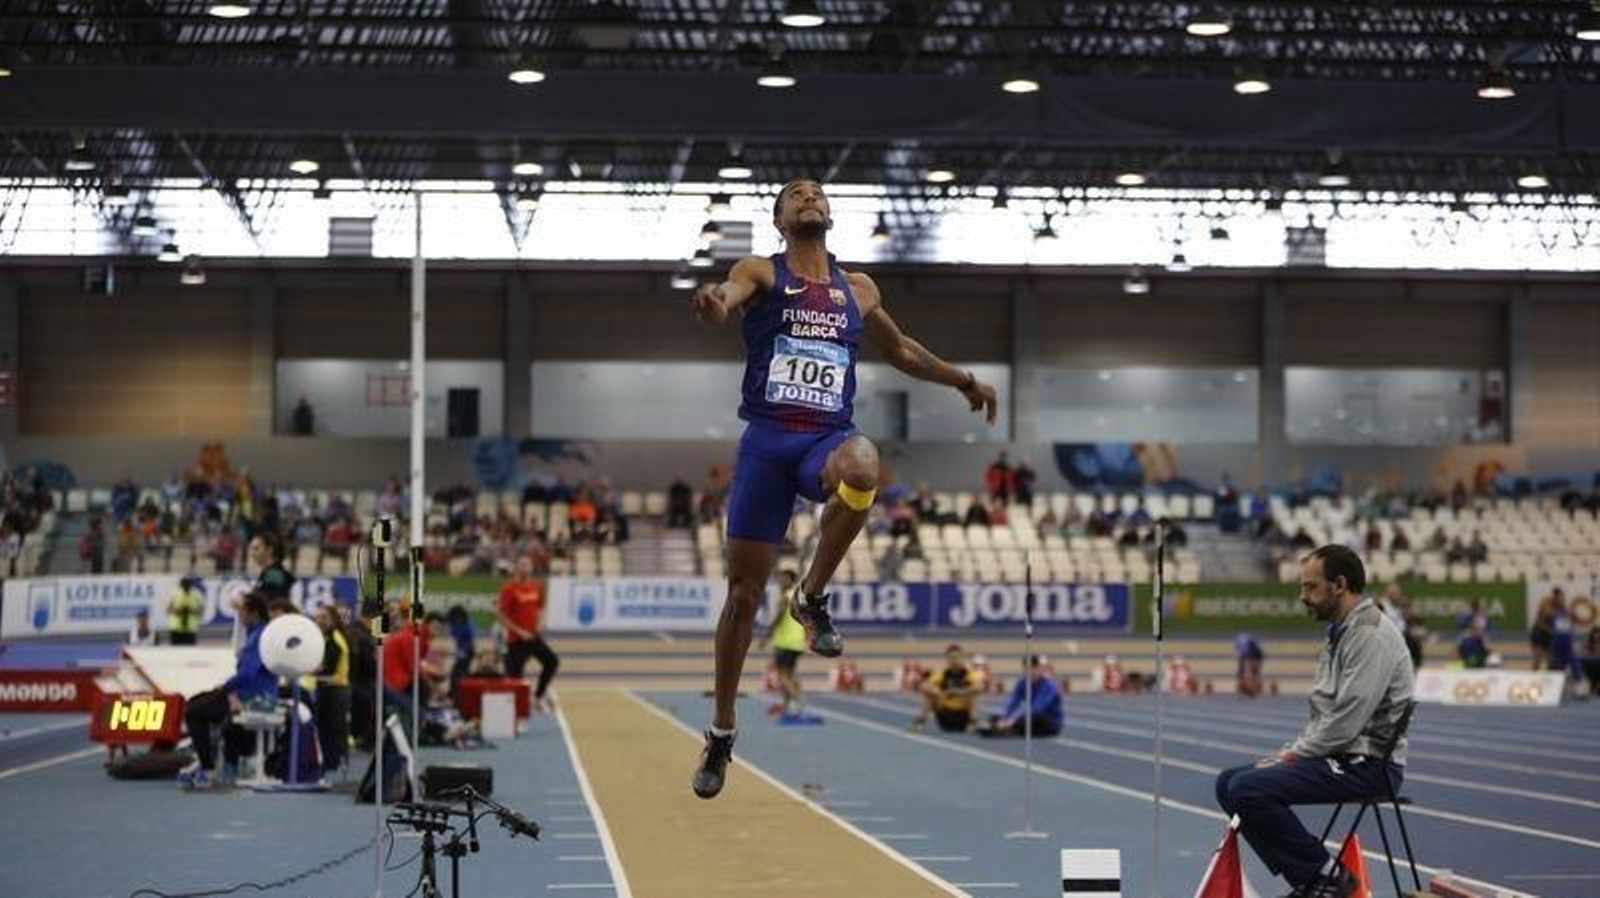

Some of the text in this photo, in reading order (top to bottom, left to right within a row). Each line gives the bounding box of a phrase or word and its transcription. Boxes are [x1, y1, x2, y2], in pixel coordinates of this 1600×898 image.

[783, 309, 848, 328] FUNDACIÓ
[791, 323, 838, 338] BARÇA
[787, 358, 835, 388] 106
[0, 683, 77, 703] MONDO
[109, 701, 166, 731] 1:00
